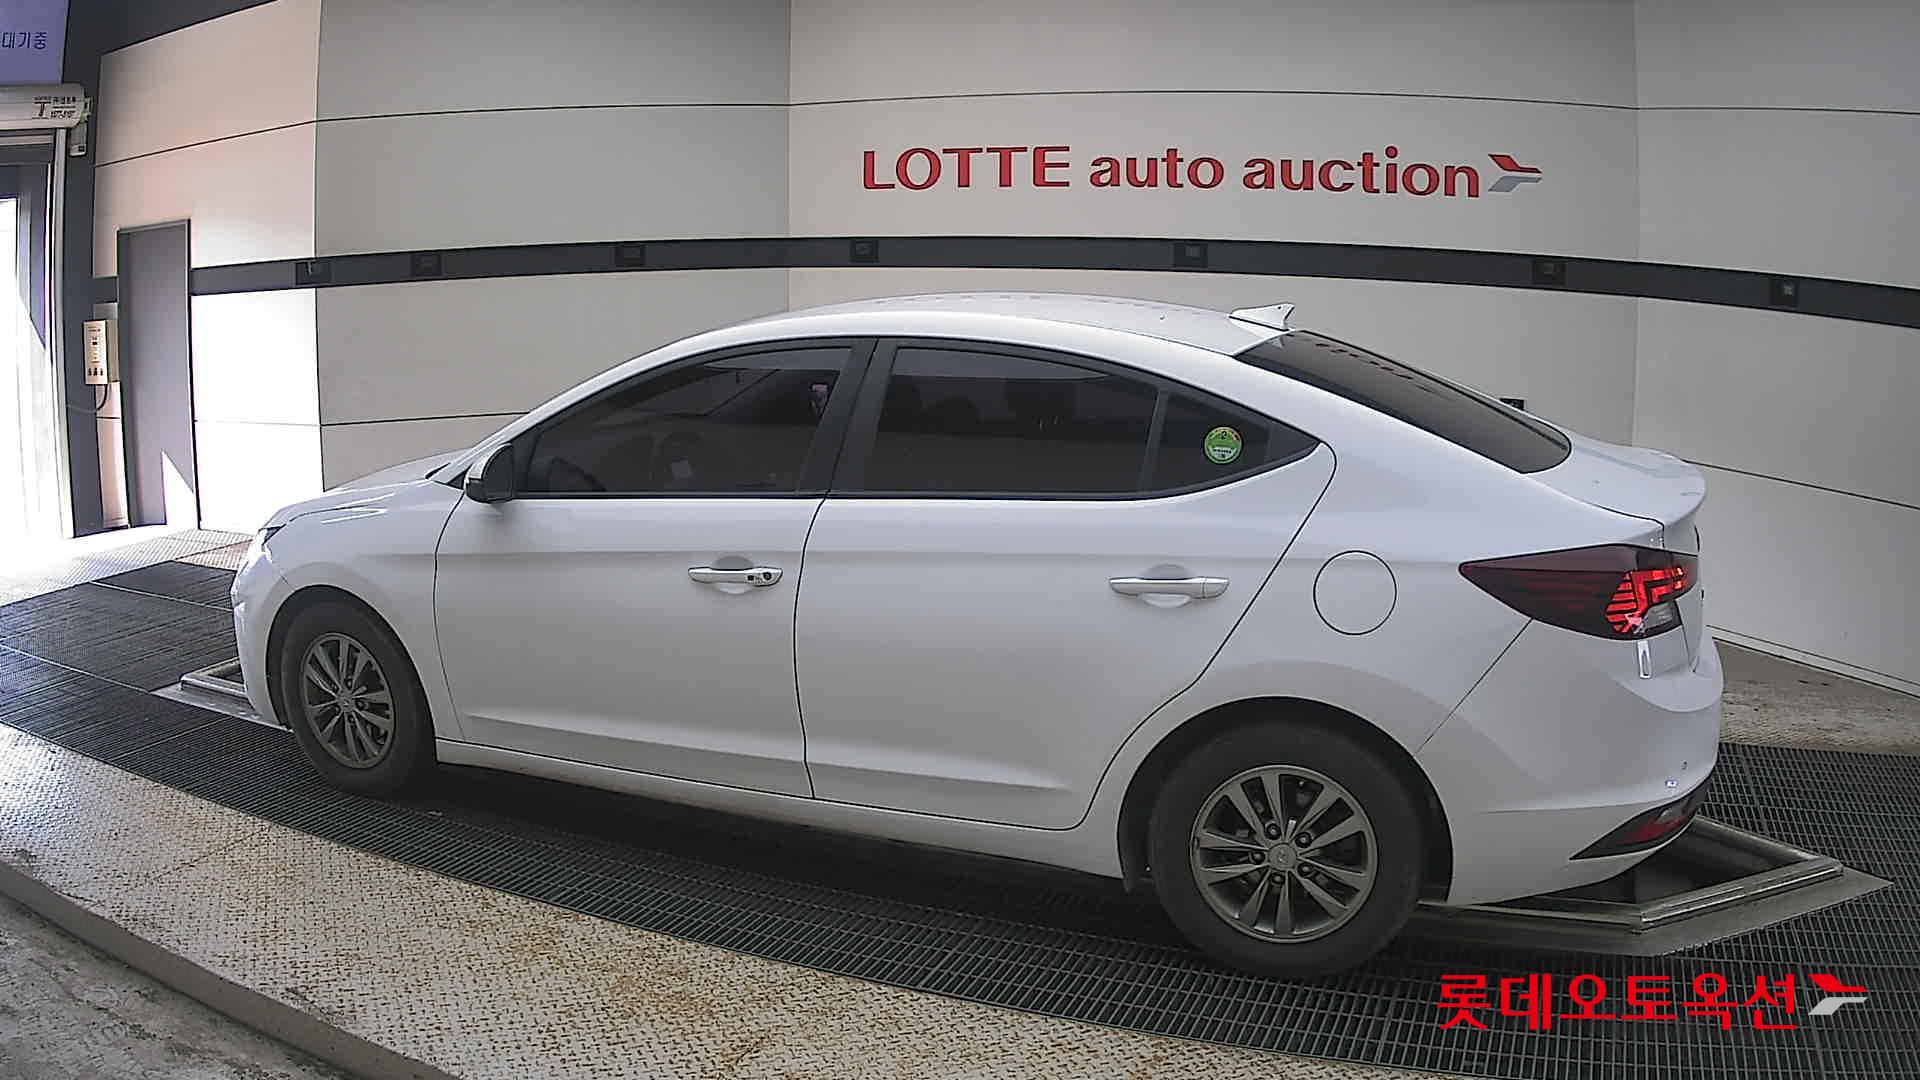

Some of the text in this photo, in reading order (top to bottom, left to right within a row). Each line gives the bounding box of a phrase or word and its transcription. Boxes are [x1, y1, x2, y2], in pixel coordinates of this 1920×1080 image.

[863, 146, 1480, 197] LOTTE auto auction
